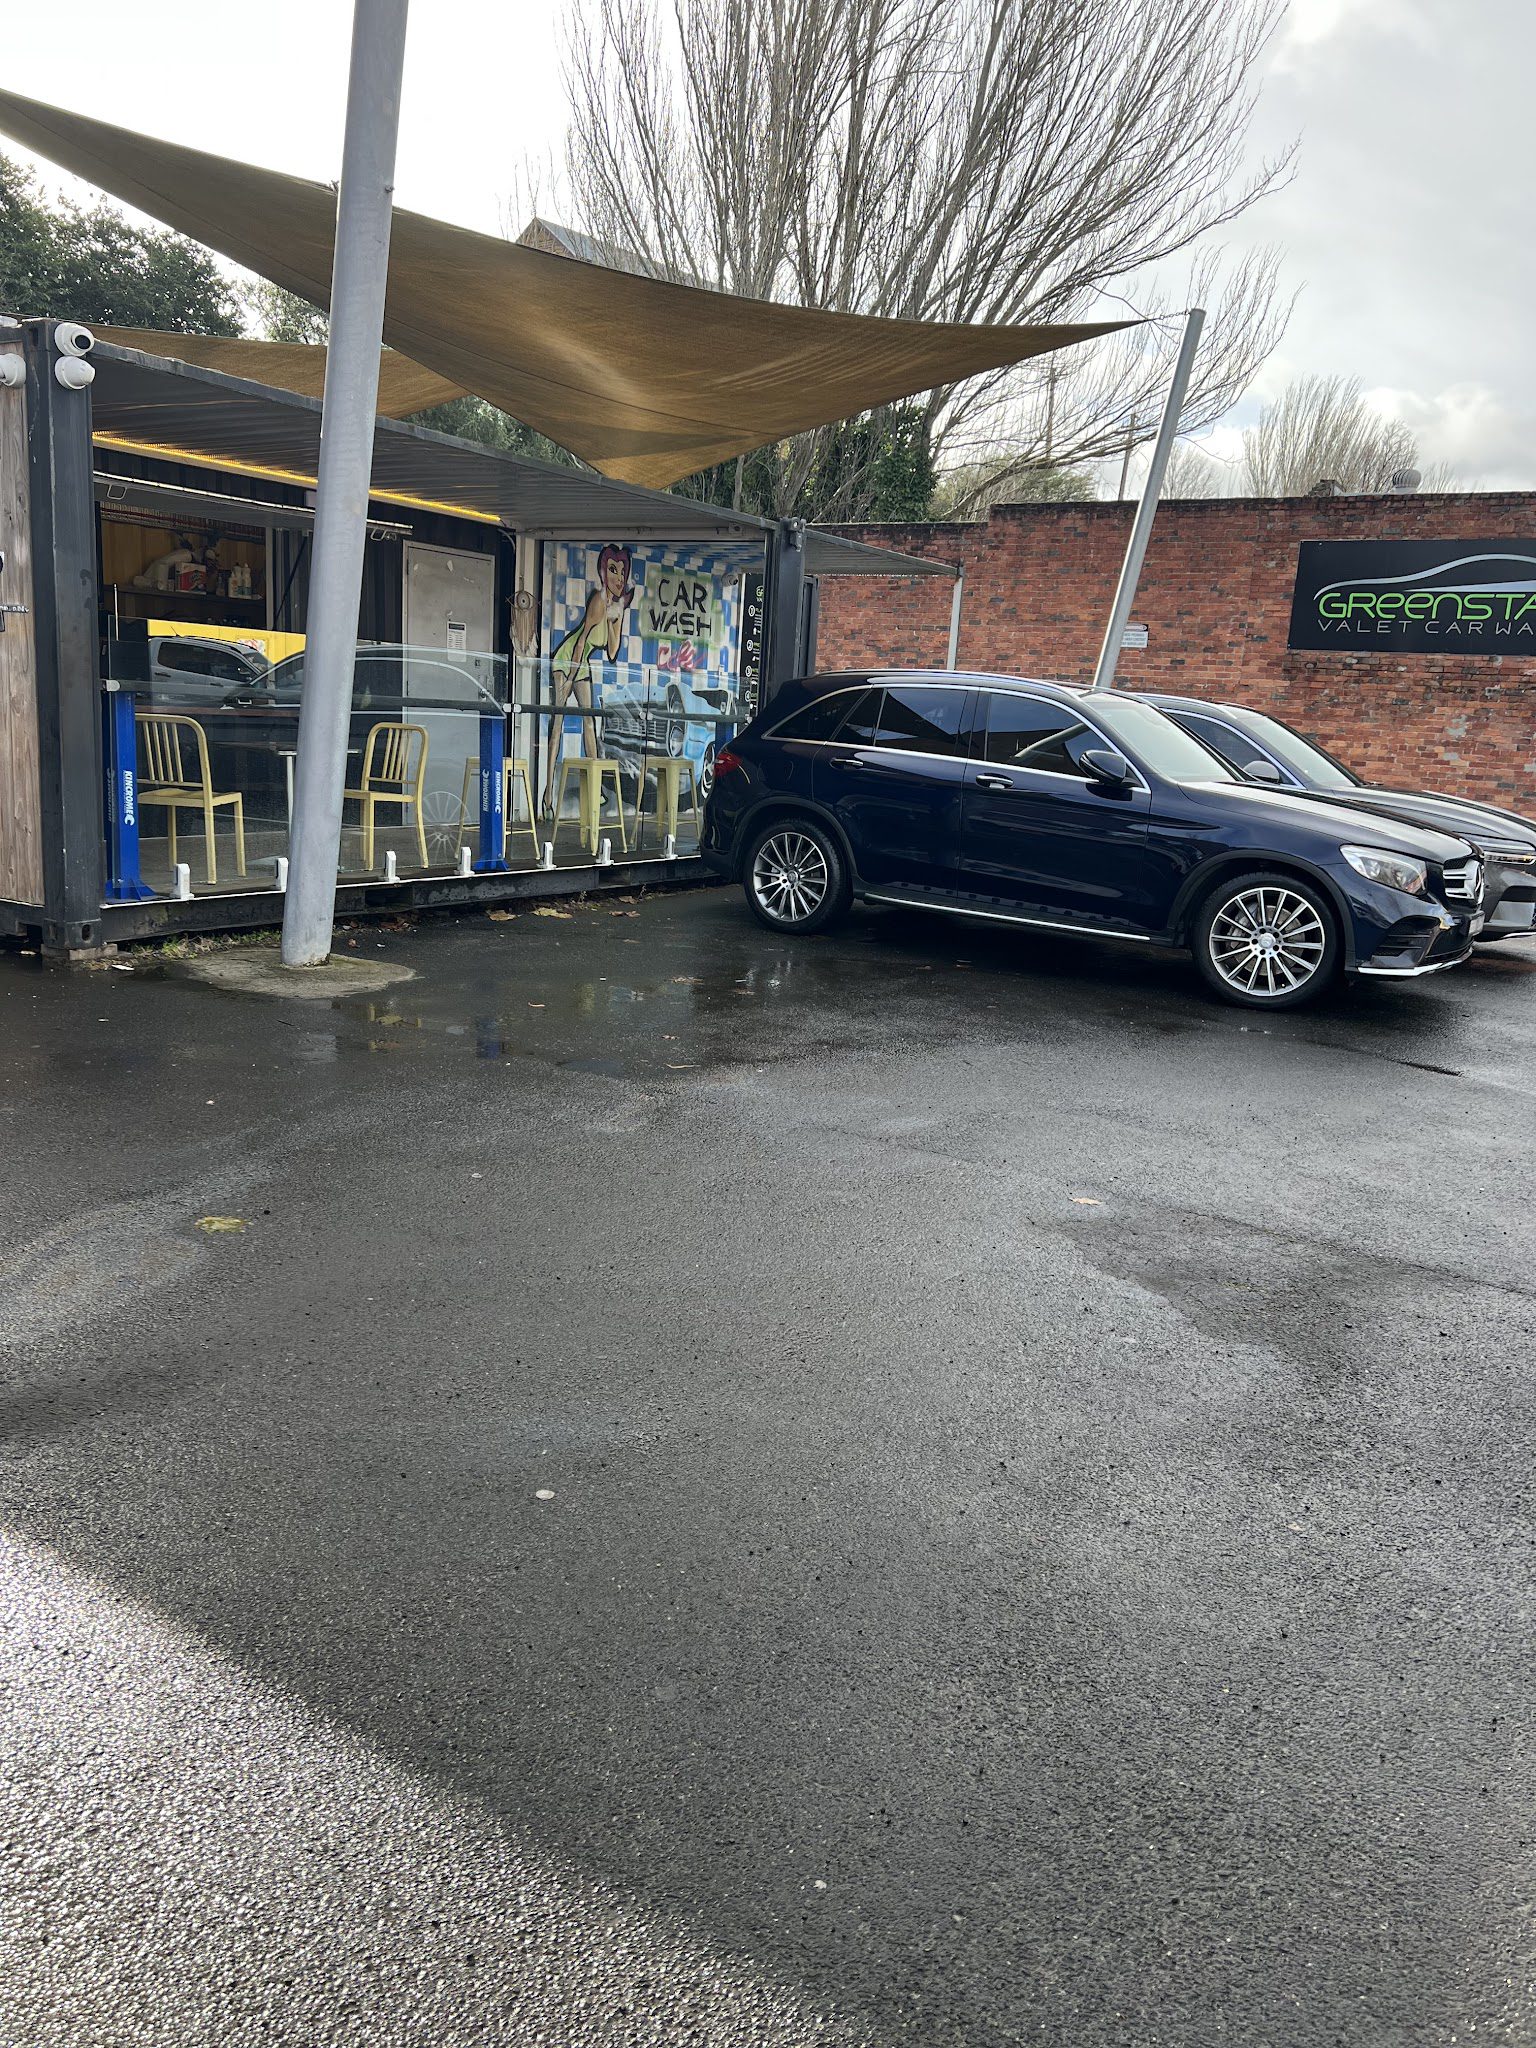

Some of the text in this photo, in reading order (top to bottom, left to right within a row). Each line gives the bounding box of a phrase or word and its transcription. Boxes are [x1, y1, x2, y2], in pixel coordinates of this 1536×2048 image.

[659, 579, 707, 613] CAR
[650, 609, 712, 637] WASH
[1318, 620, 1534, 635] VALET CAR WA
[125, 770, 134, 816] KINCROME
